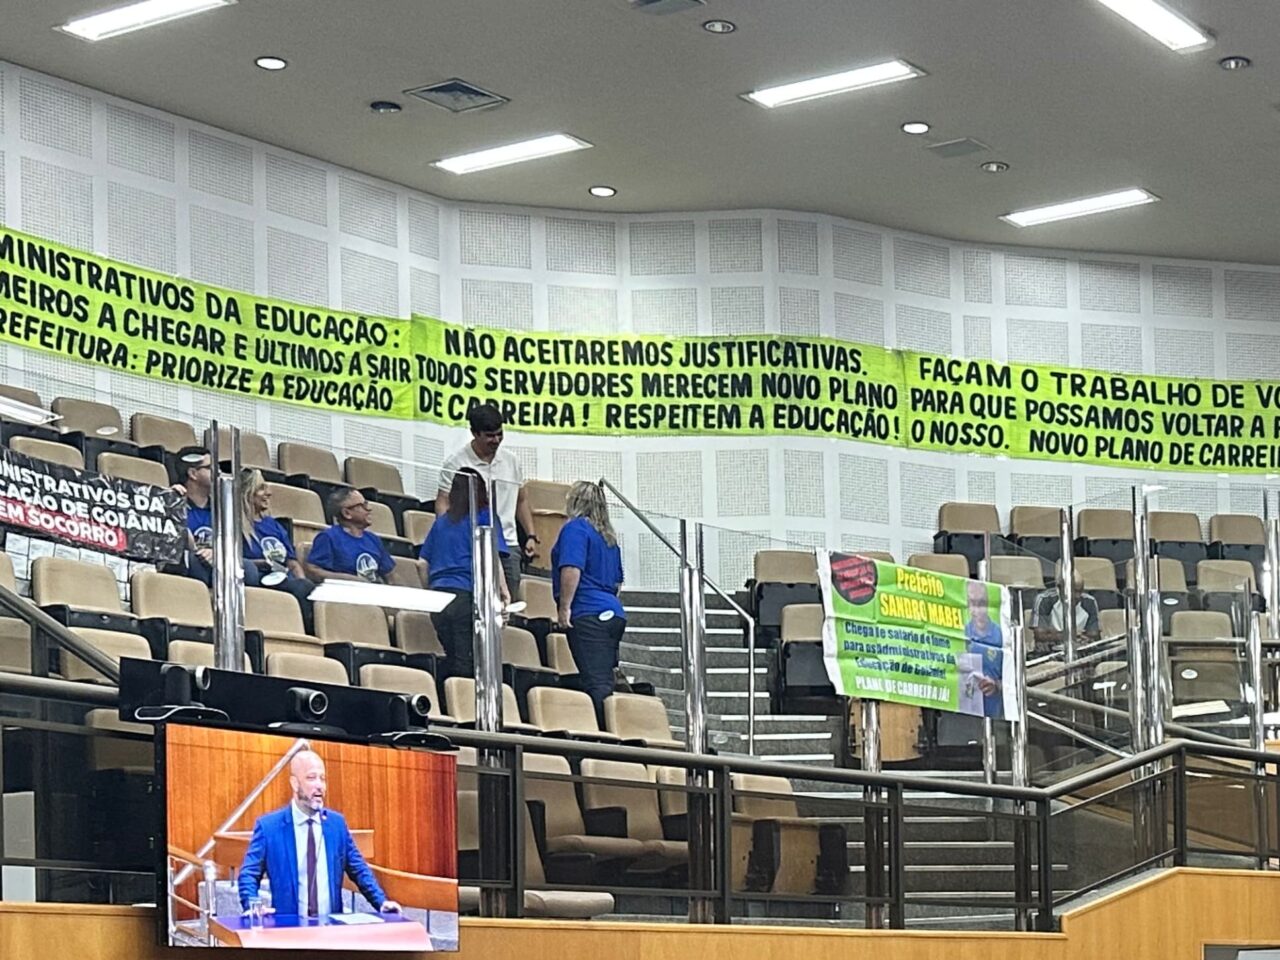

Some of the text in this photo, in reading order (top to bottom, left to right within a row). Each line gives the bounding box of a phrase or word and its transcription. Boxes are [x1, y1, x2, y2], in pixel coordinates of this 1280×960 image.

[206, 292, 242, 325] DA
[97, 302, 117, 332] A
[123, 308, 226, 356] CHEGAR
[234, 333, 248, 360] E
[255, 333, 346, 376] ÚLTIMOS
[349, 352, 363, 376] A
[366, 353, 412, 383] SAIR
[445, 327, 868, 376] NÃO ACEITAREMOS JUSTIFICATIVAS.
[145, 349, 254, 393] PRIORIZE
[259, 371, 275, 396] A
[283, 375, 394, 412] EDUCAÇÃO
[415, 354, 898, 409] TODOS SERVIDORES MERECEM NOVO PLANO
[919, 357, 1012, 389] FAÇAM
[1021, 369, 1039, 392] O
[1050, 371, 1201, 406] TRABALHO
[1212, 384, 1245, 409] DE
[419, 385, 900, 440] DE CAREIRA! RESPEITEM A EDUCAÇÃO!
[911, 388, 964, 414] PARA
[970, 393, 1017, 420] QUE
[1025, 399, 1154, 434] POSSAMOS
[1162, 411, 1244, 438] VOLTAR
[1250, 415, 1265, 438] A
[911, 419, 925, 443] O
[930, 420, 1010, 449] NOSSO.
[1030, 429, 1088, 457] NOVO
[1095, 435, 1163, 464] PLANO
[1169, 442, 1194, 465] DE
[61, 502, 89, 519] DE
[92, 506, 178, 536] GOIÂNIA
[134, 495, 166, 514] DA
[896, 567, 944, 598] Prefeito
[845, 621, 874, 637] Chega
[880, 592, 964, 630] SANDRO MABEL
[844, 640, 864, 652] para
